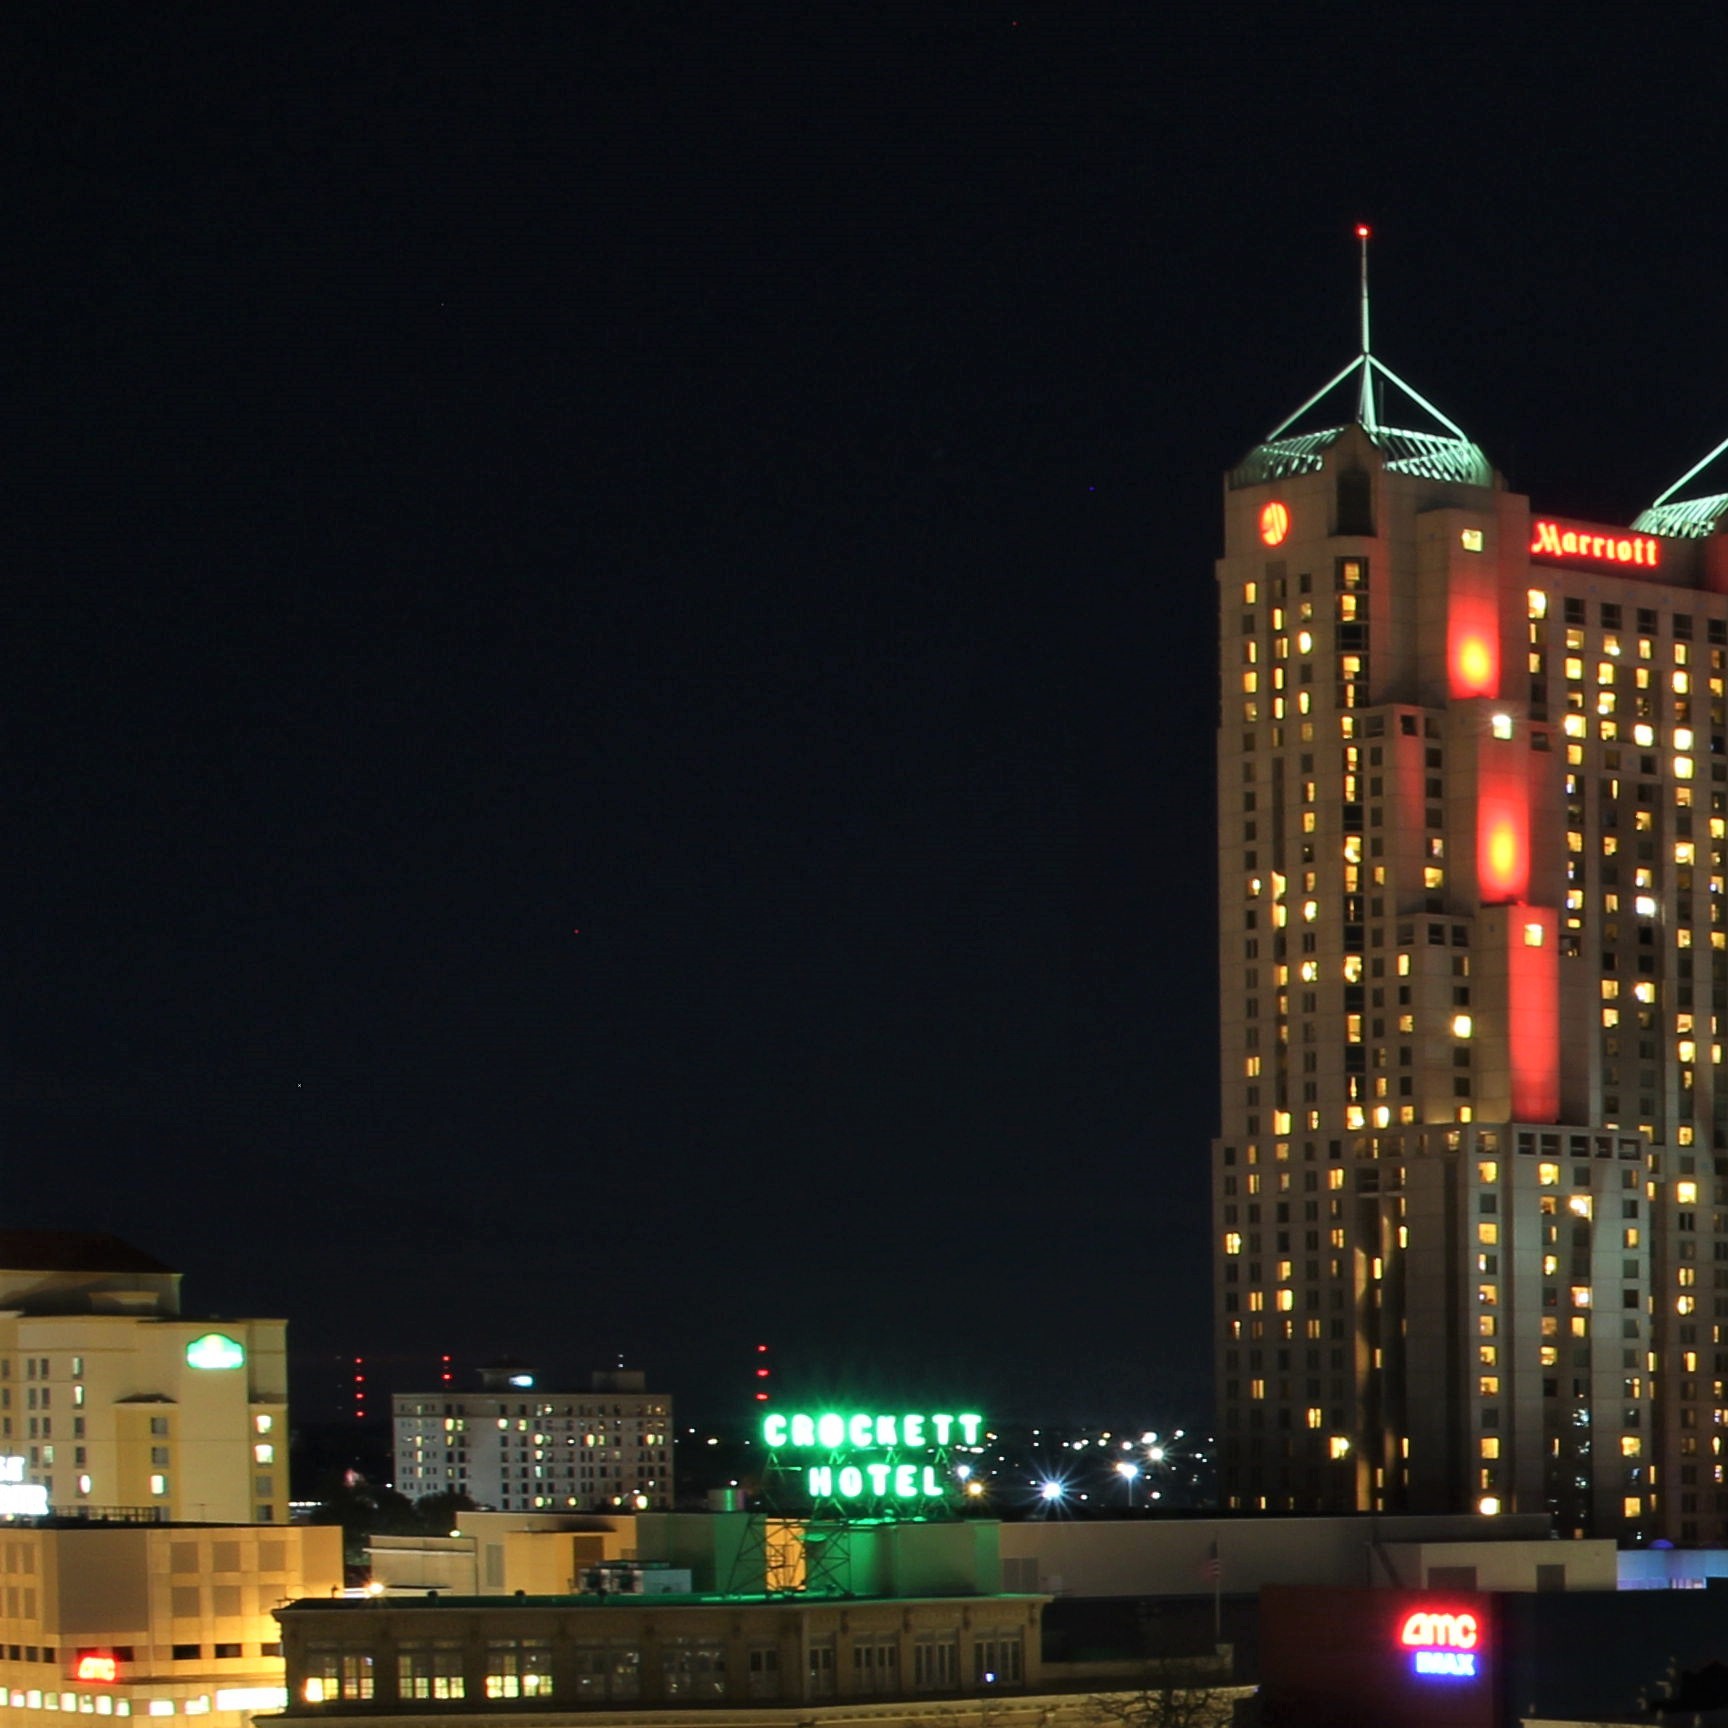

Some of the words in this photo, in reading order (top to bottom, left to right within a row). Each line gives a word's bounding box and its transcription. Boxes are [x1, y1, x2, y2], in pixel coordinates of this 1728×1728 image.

[1531, 522, 1657, 566] Marriott
[763, 1413, 983, 1448] CROCKETT
[808, 1464, 944, 1497] HOTEL
[1416, 1651, 1476, 1677] IMAX
